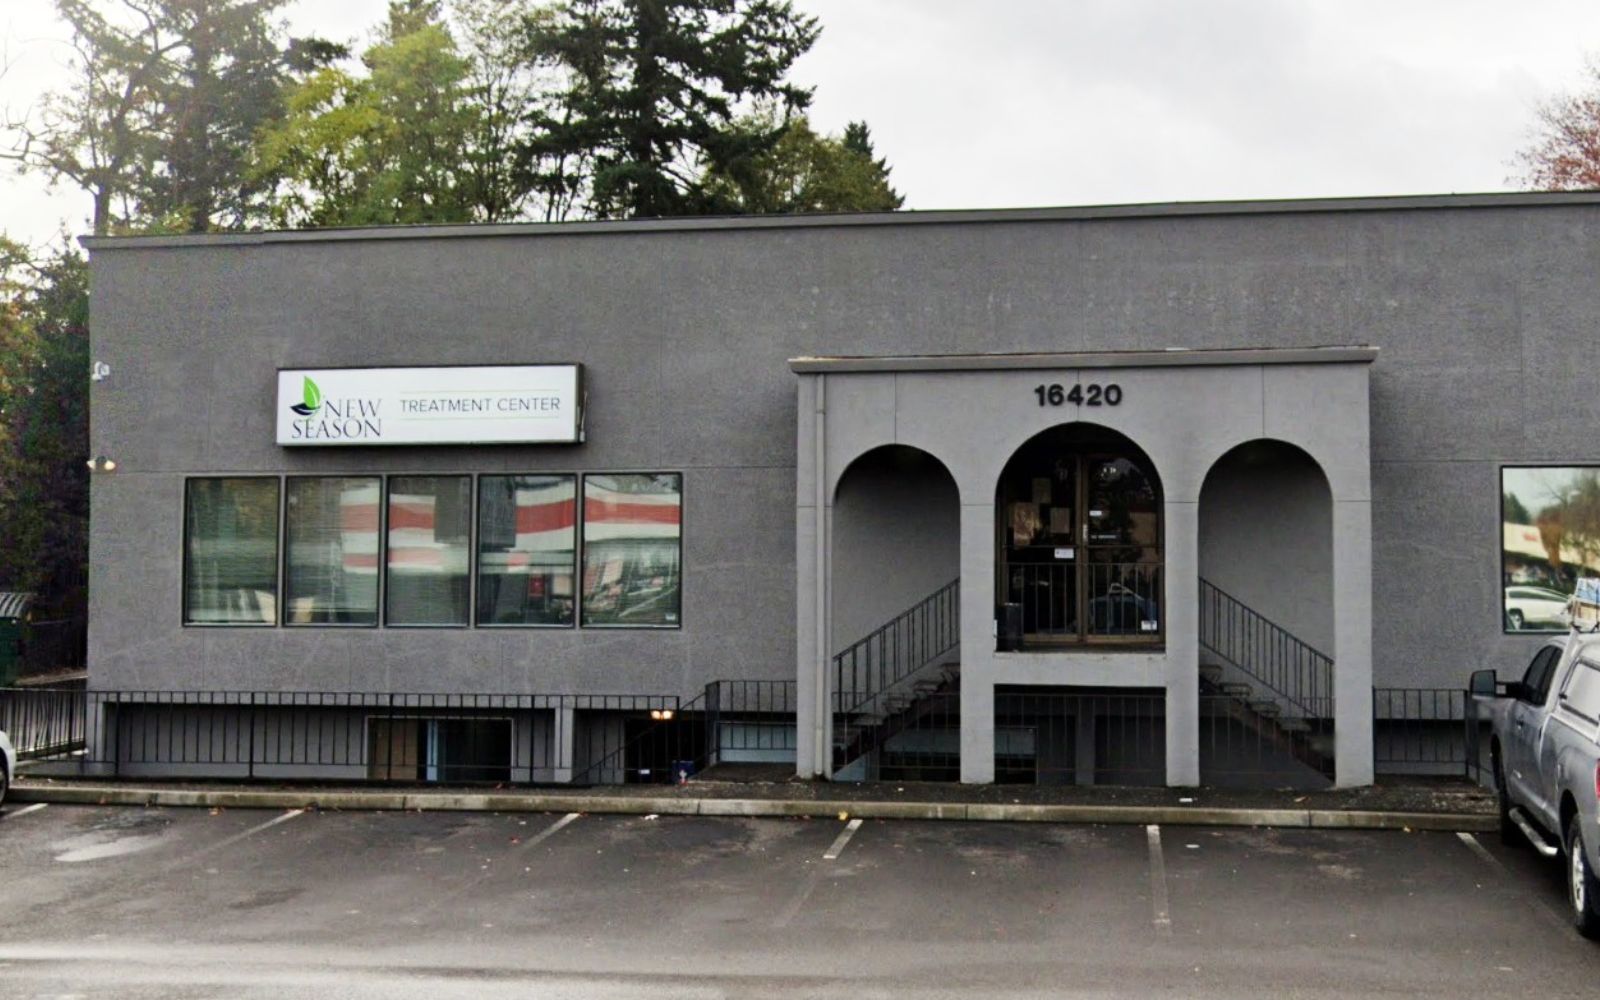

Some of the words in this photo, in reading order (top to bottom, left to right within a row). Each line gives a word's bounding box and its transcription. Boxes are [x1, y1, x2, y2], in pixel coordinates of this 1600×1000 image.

[400, 398, 491, 413] TREATMENT
[497, 397, 561, 412] CENTER
[1034, 384, 1123, 407] 16420
[324, 398, 382, 417] NEW
[291, 418, 382, 439] SEASON
